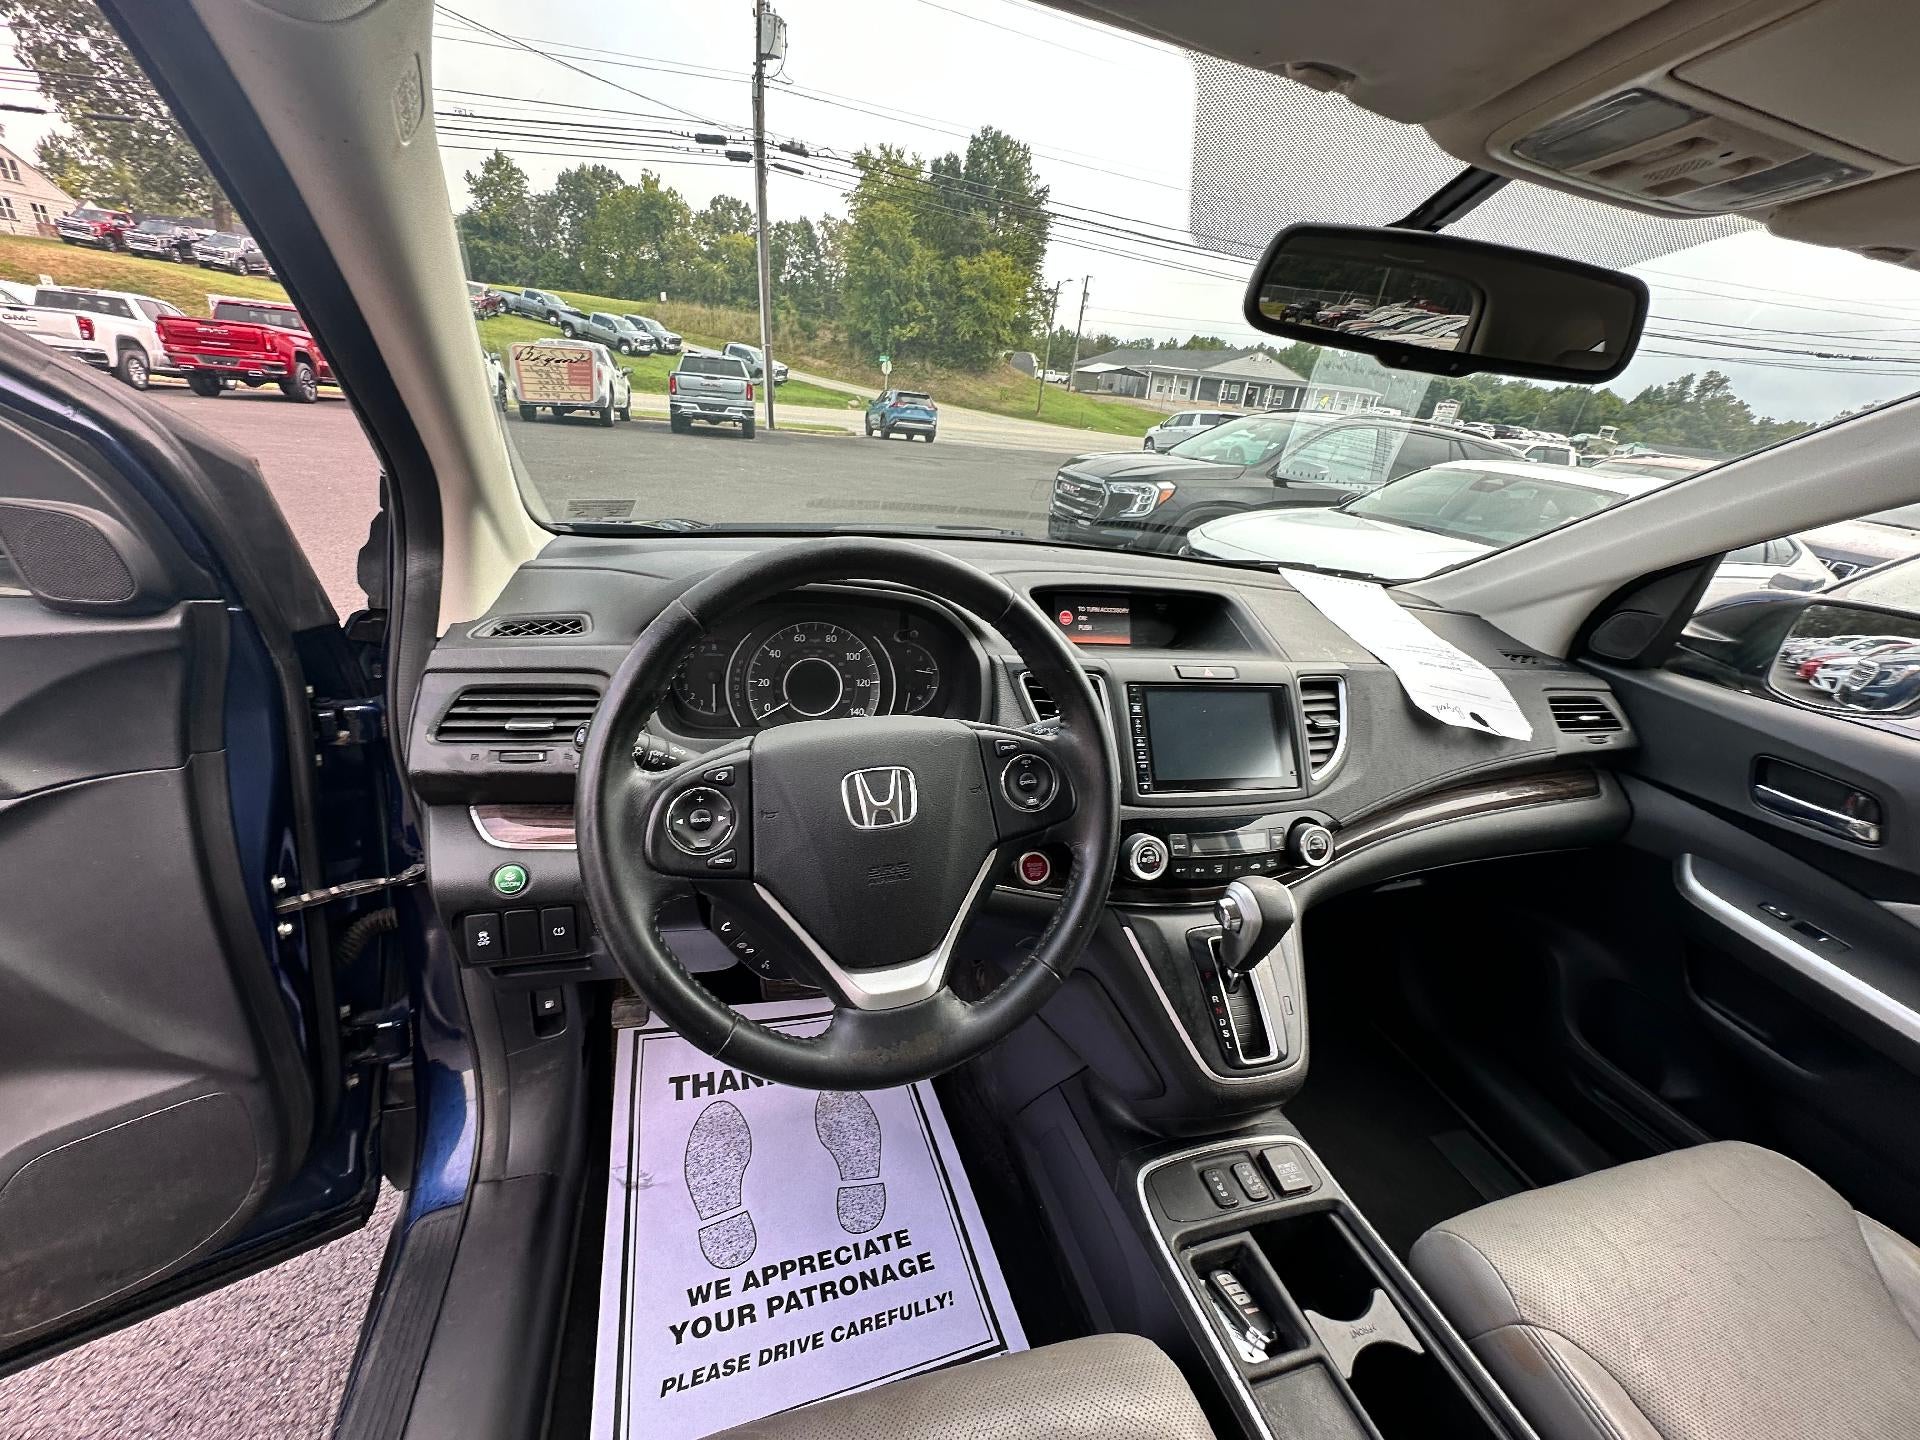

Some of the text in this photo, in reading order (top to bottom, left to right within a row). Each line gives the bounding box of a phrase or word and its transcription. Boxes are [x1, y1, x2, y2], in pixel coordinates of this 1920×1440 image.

[793, 634, 806, 642] 60
[825, 634, 838, 643] 80
[769, 649, 781, 658] 40
[846, 652, 861, 661] 100
[757, 678, 770, 687] 20
[855, 678, 871, 687] 120
[763, 702, 771, 712] 0
[850, 707, 865, 716] 140
[1211, 995, 1220, 1003] R
[1219, 1018, 1226, 1026] D
[1222, 1029, 1231, 1038] S
[1225, 1041, 1232, 1049] L
[668, 1069, 775, 1101] THAN
[686, 1228, 913, 1308] WE APPRECIATE
[668, 1251, 936, 1346] YOUR PATRONAGE
[660, 1290, 956, 1399] PLEASE DRIVE CAREFULLY!
